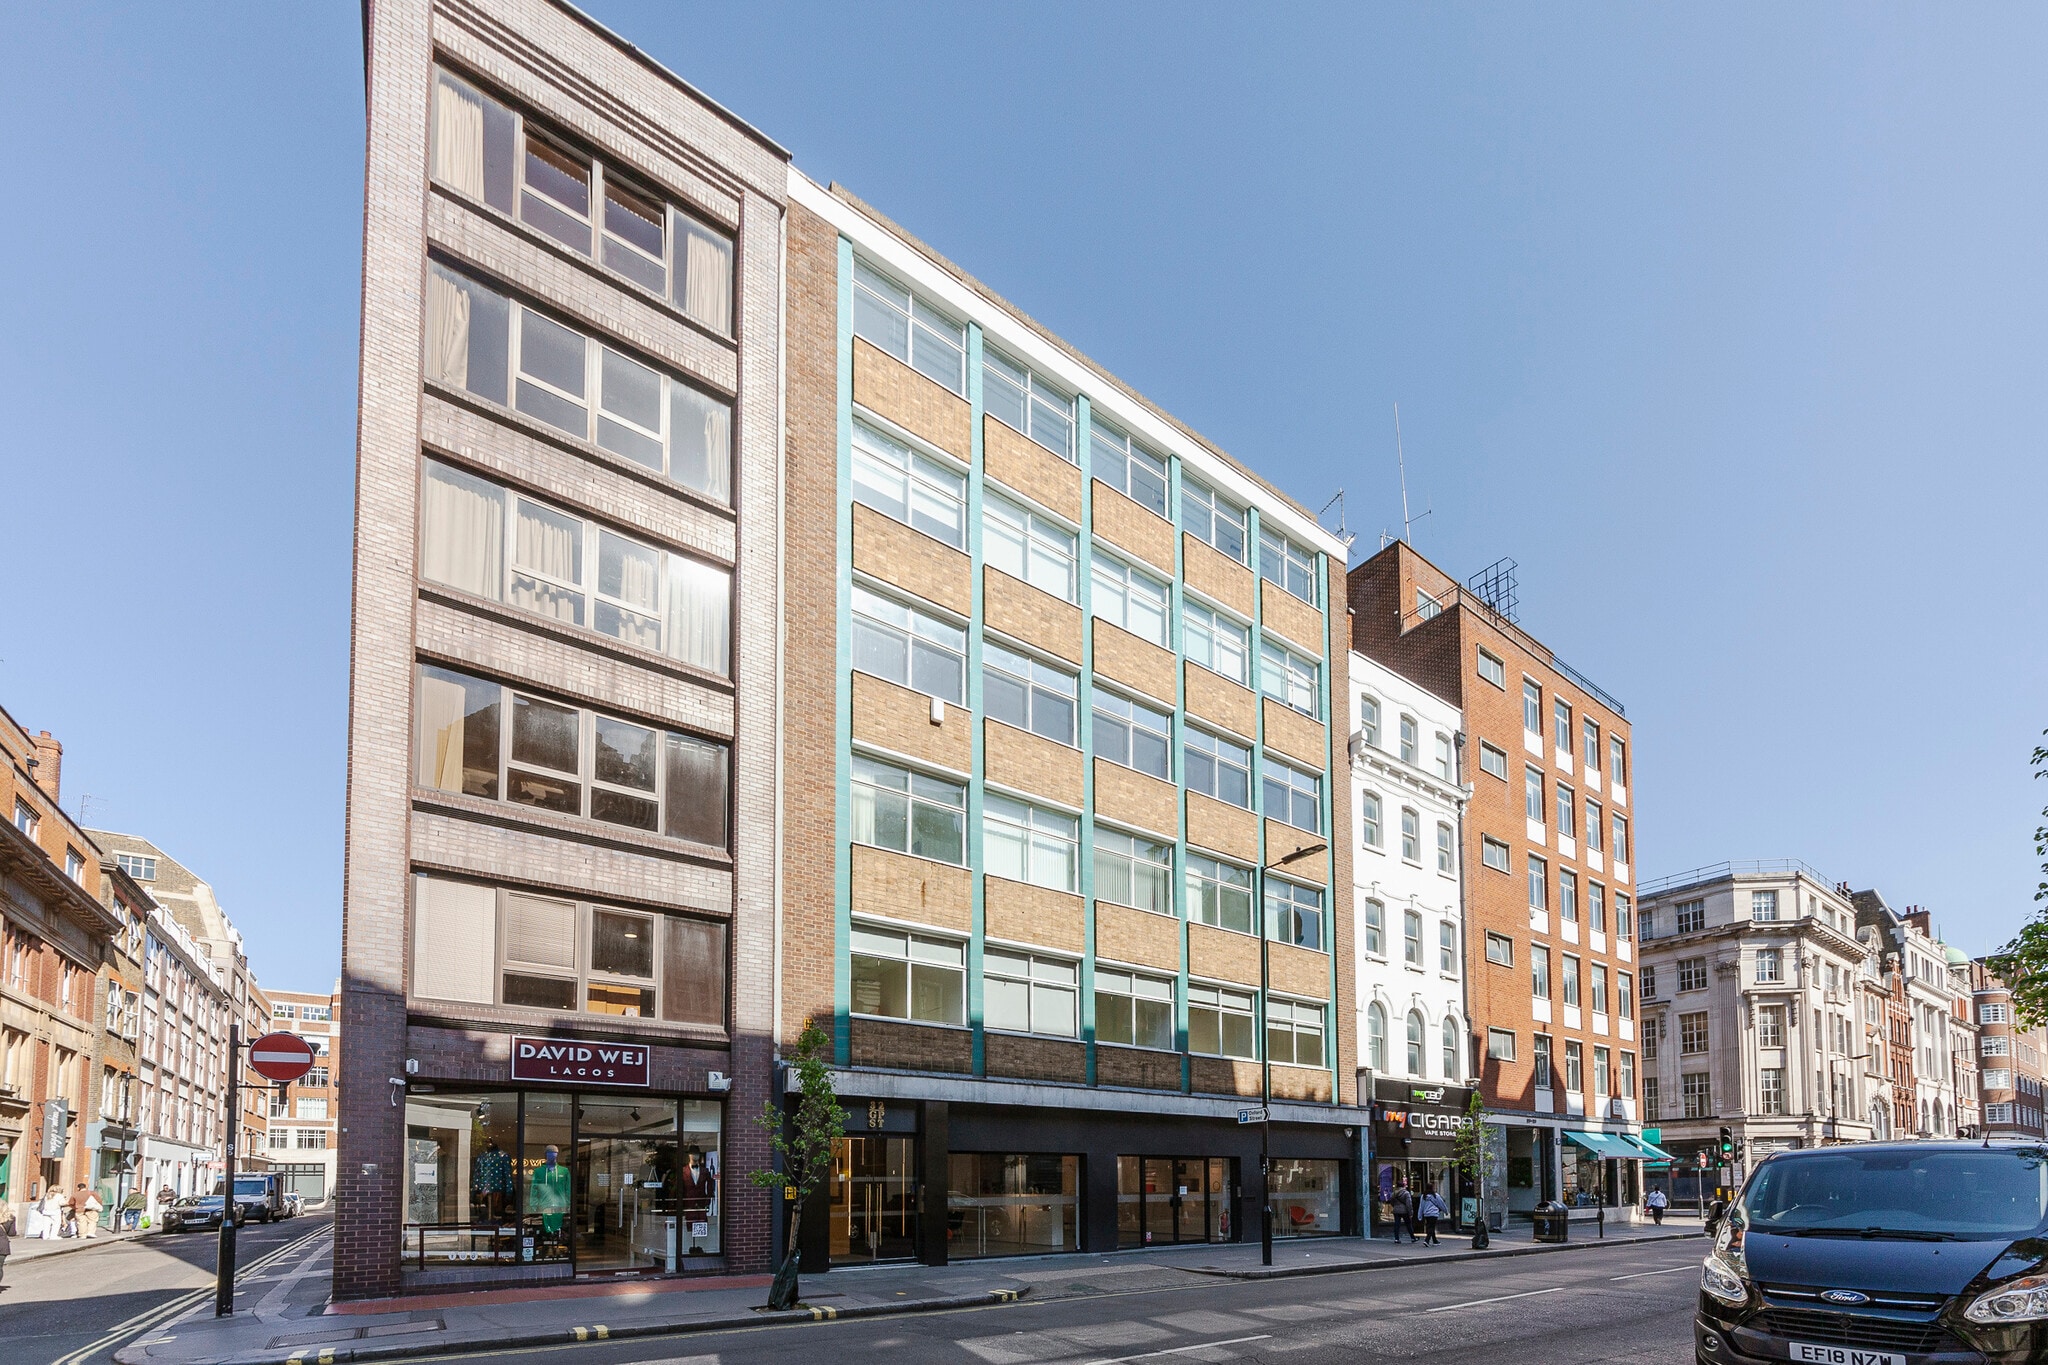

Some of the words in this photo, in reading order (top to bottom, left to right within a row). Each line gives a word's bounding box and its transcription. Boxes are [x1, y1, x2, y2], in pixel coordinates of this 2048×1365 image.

[520, 1043, 593, 1062] DAVID
[598, 1049, 643, 1066] WEJ
[550, 1066, 615, 1077] LAGOS
[1830, 1291, 1857, 1301] Ford
[1801, 1345, 1846, 1364] EF18
